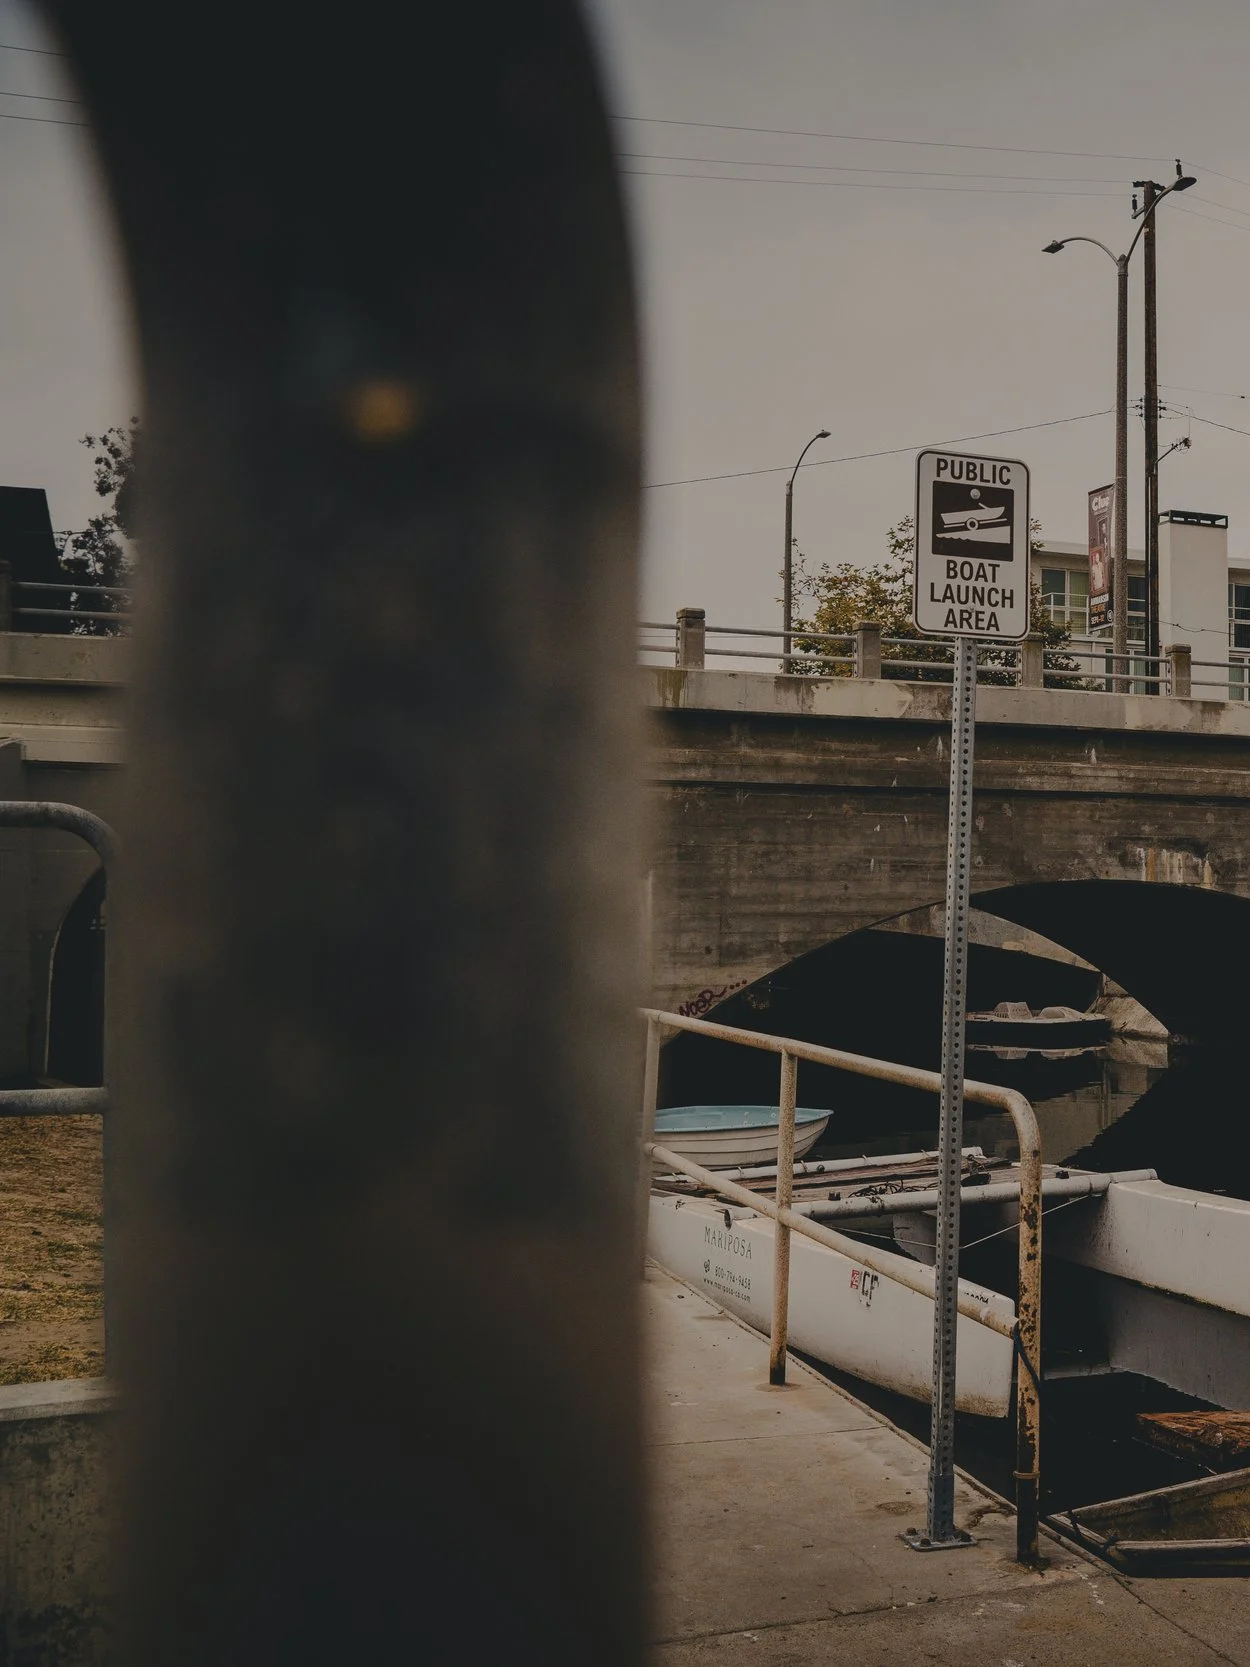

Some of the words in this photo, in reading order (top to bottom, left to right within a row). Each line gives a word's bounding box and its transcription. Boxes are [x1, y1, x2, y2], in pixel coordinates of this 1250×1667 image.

[936, 457, 1012, 486] PUBLIC
[946, 559, 1000, 583] BOAT
[930, 582, 1014, 609] LAUNCH
[944, 608, 1000, 632] AREA
[704, 1226, 752, 1259] MARIPOSA
